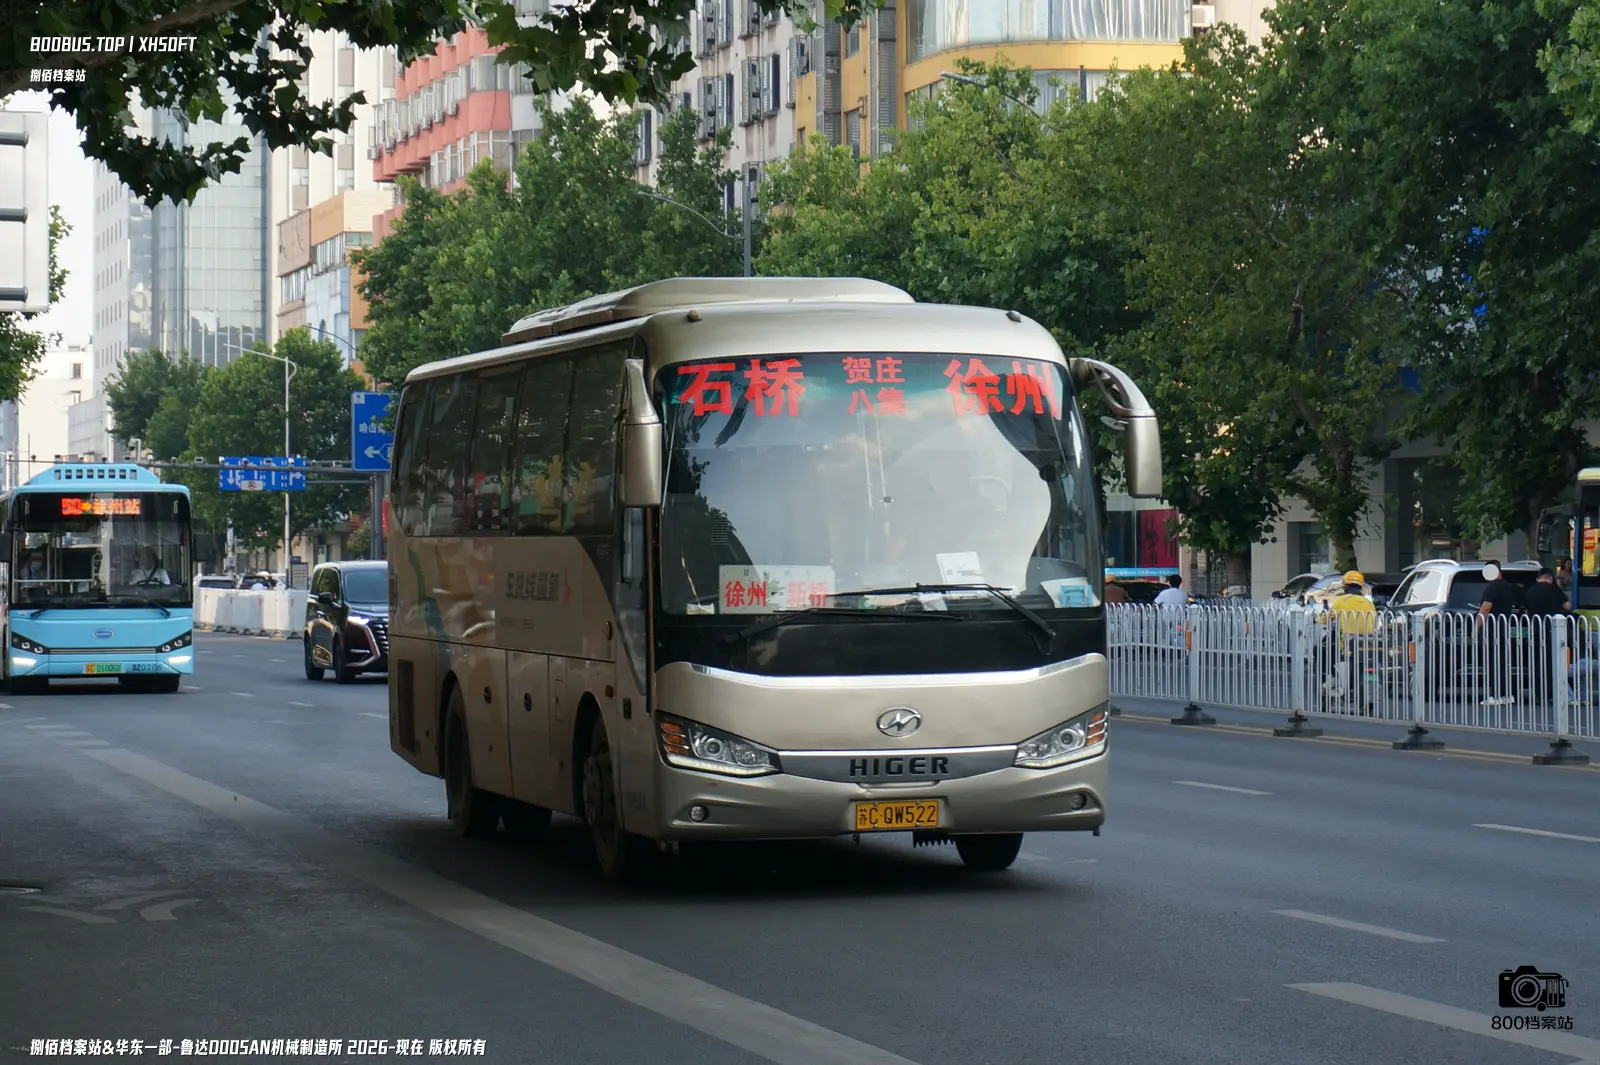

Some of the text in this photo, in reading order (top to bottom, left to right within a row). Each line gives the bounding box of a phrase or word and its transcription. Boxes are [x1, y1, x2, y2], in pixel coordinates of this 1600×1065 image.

[842, 356, 906, 384] 贺庄
[677, 358, 806, 417] 石桥
[847, 387, 907, 416] 八集
[943, 358, 1063, 420] 徐州
[93, 498, 141, 515] 徐州站
[724, 580, 768, 608] 徐州
[849, 756, 949, 777] HIGER
